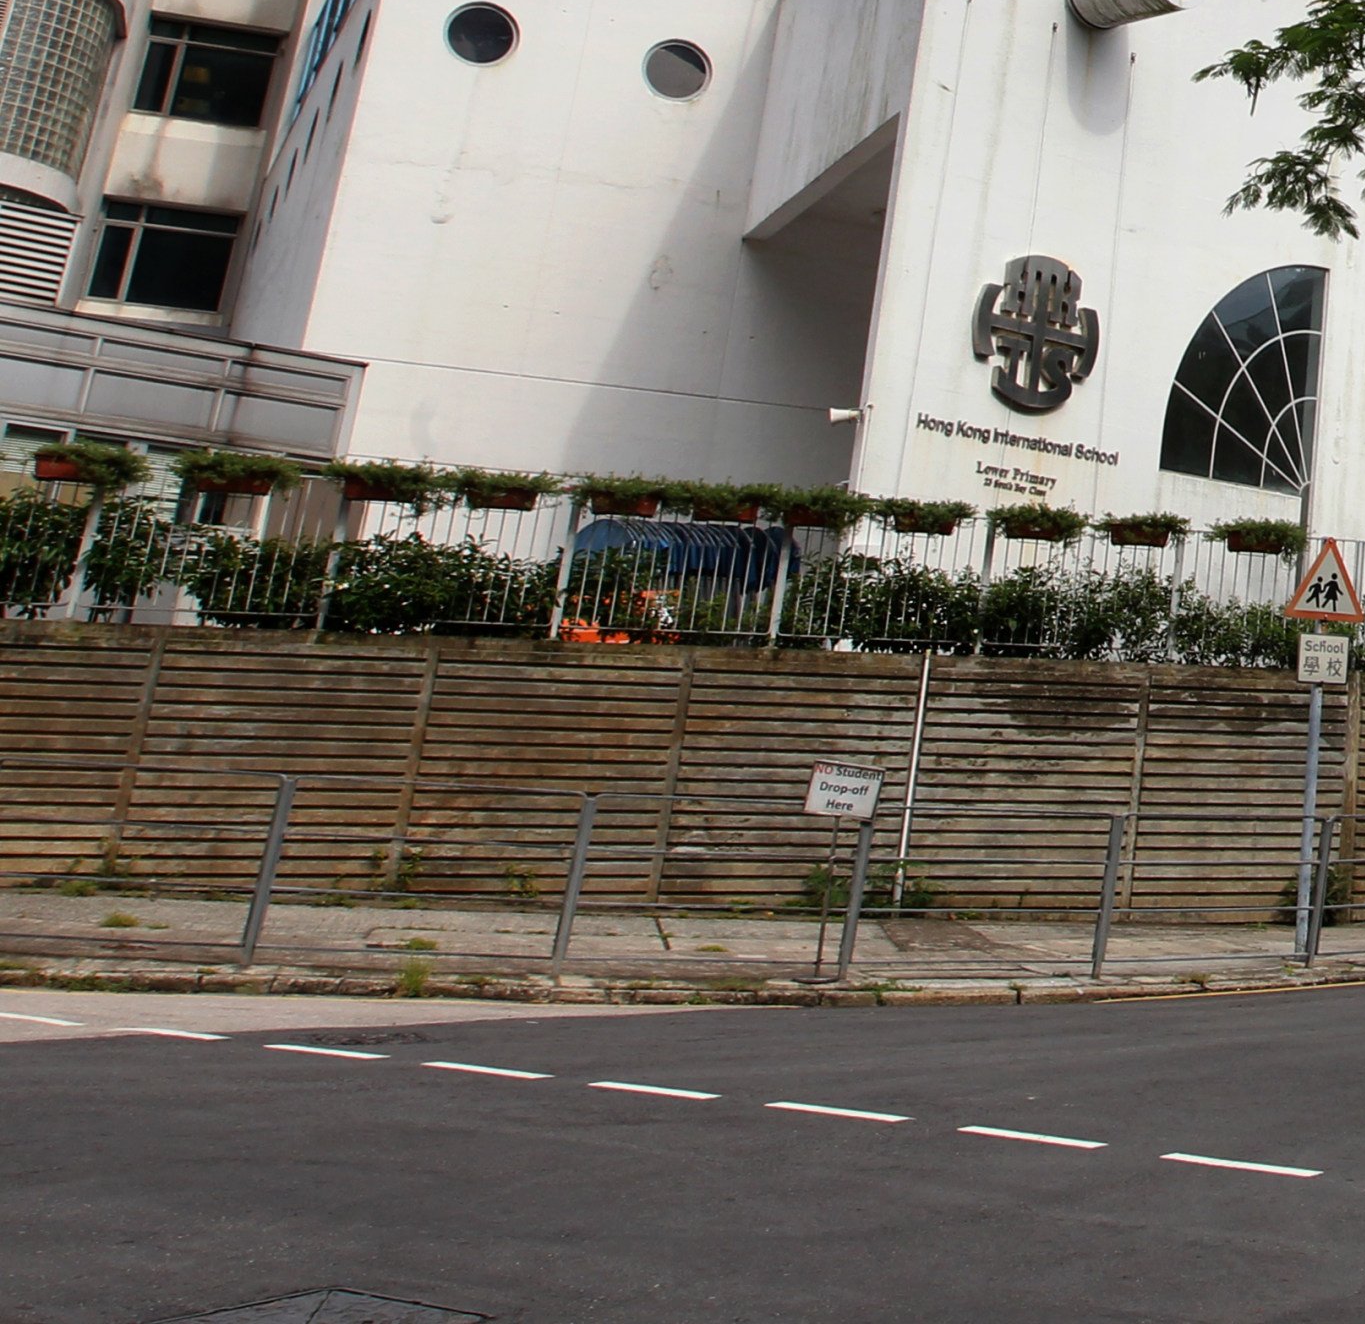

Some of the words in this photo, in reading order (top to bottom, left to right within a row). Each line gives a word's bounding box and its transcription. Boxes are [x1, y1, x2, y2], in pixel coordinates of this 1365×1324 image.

[916, 413, 953, 437] Hong
[956, 420, 991, 444] Kong
[993, 428, 1073, 458] International
[1075, 444, 1119, 467] School
[976, 460, 1011, 478] Lower
[1012, 468, 1057, 490] Primary
[1304, 640, 1344, 654] School
[1303, 656, 1343, 677] 學校
[815, 764, 834, 775] NO
[835, 766, 882, 781] Student
[819, 781, 870, 796] Drop-off
[825, 799, 854, 812] Here
